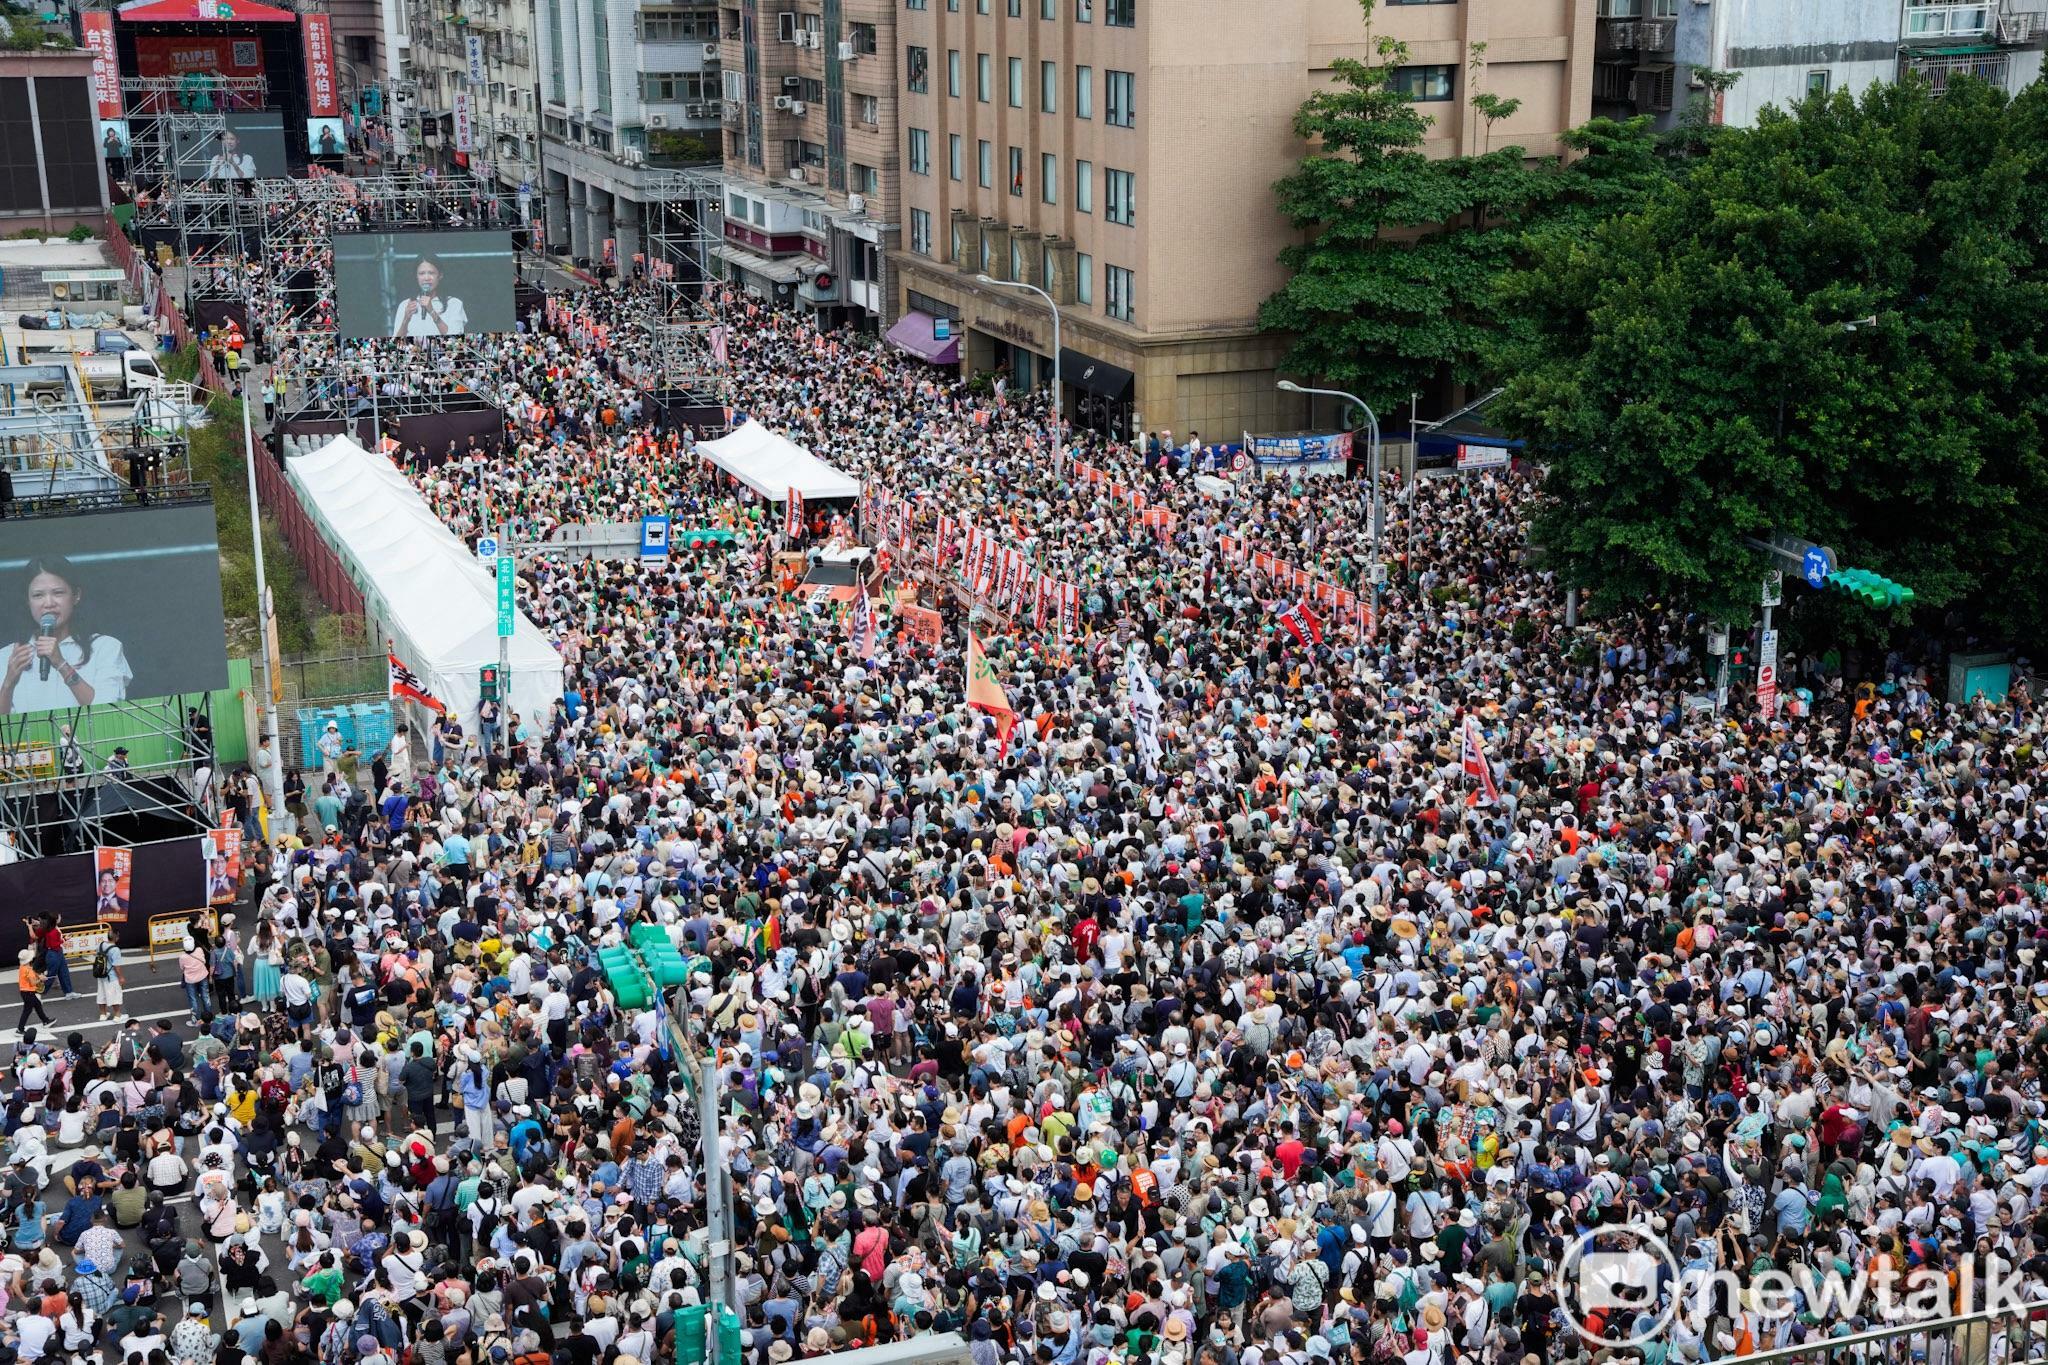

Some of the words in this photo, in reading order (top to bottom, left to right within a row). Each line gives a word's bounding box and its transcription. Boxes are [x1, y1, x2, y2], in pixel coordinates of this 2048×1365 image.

[101, 29, 114, 60] SOON
[172, 49, 217, 63] TAIPEI
[106, 63, 119, 103] FUTURE
[314, 61, 331, 108] 沈伯洋
[1235, 457, 1244, 468] 15
[501, 564, 510, 610] 北平東路
